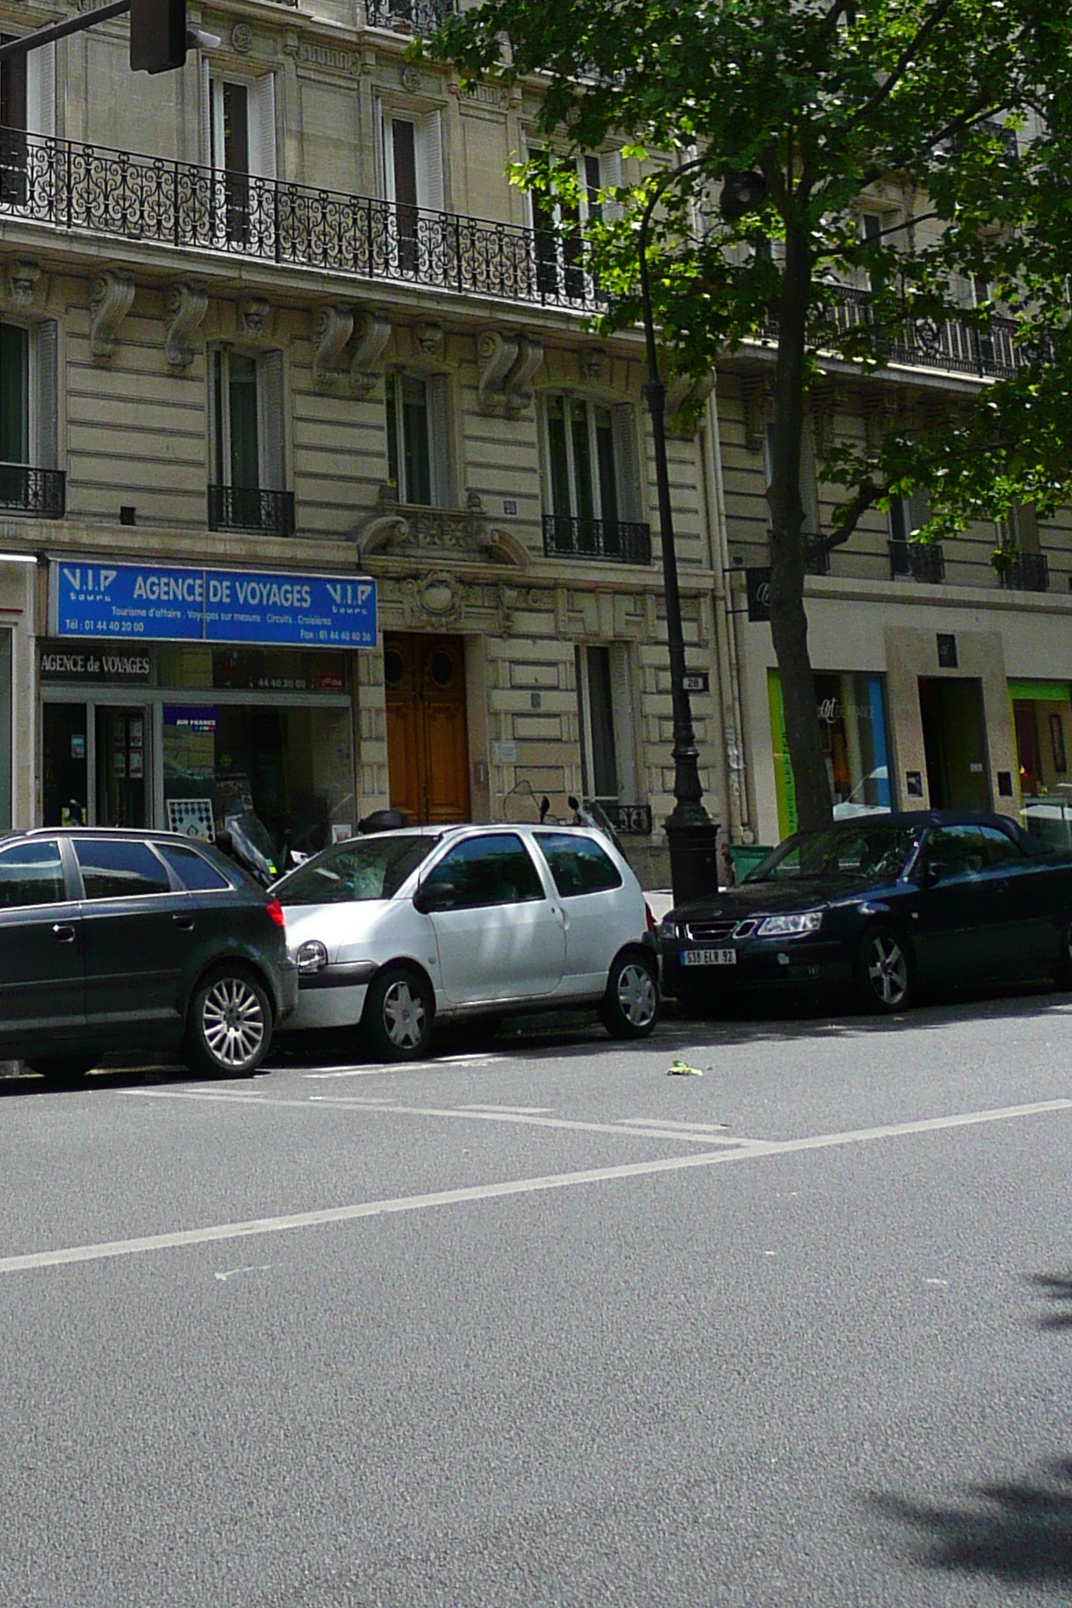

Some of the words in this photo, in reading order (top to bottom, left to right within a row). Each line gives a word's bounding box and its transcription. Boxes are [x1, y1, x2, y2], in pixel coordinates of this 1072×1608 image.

[70, 592, 111, 602] tours
[133, 576, 203, 601] AGENCE
[209, 580, 230, 602] DE
[235, 582, 311, 608] VOYAGES
[112, 606, 146, 617] Tourisme
[187, 609, 218, 622] Voyages
[221, 613, 233, 621] sur
[332, 605, 368, 614] tours
[84, 620, 94, 630] 01
[96, 621, 107, 630] 44
[109, 621, 119, 631] 40
[121, 622, 131, 631] 20
[133, 622, 144, 632] 00
[300, 629, 314, 639] Fax
[319, 630, 328, 640] 01
[330, 630, 339, 640] 44
[341, 631, 350, 641] 40
[352, 631, 360, 641] 40
[41, 654, 85, 672] AGENCE
[87, 656, 100, 672] de
[102, 656, 150, 674] VOYAGES
